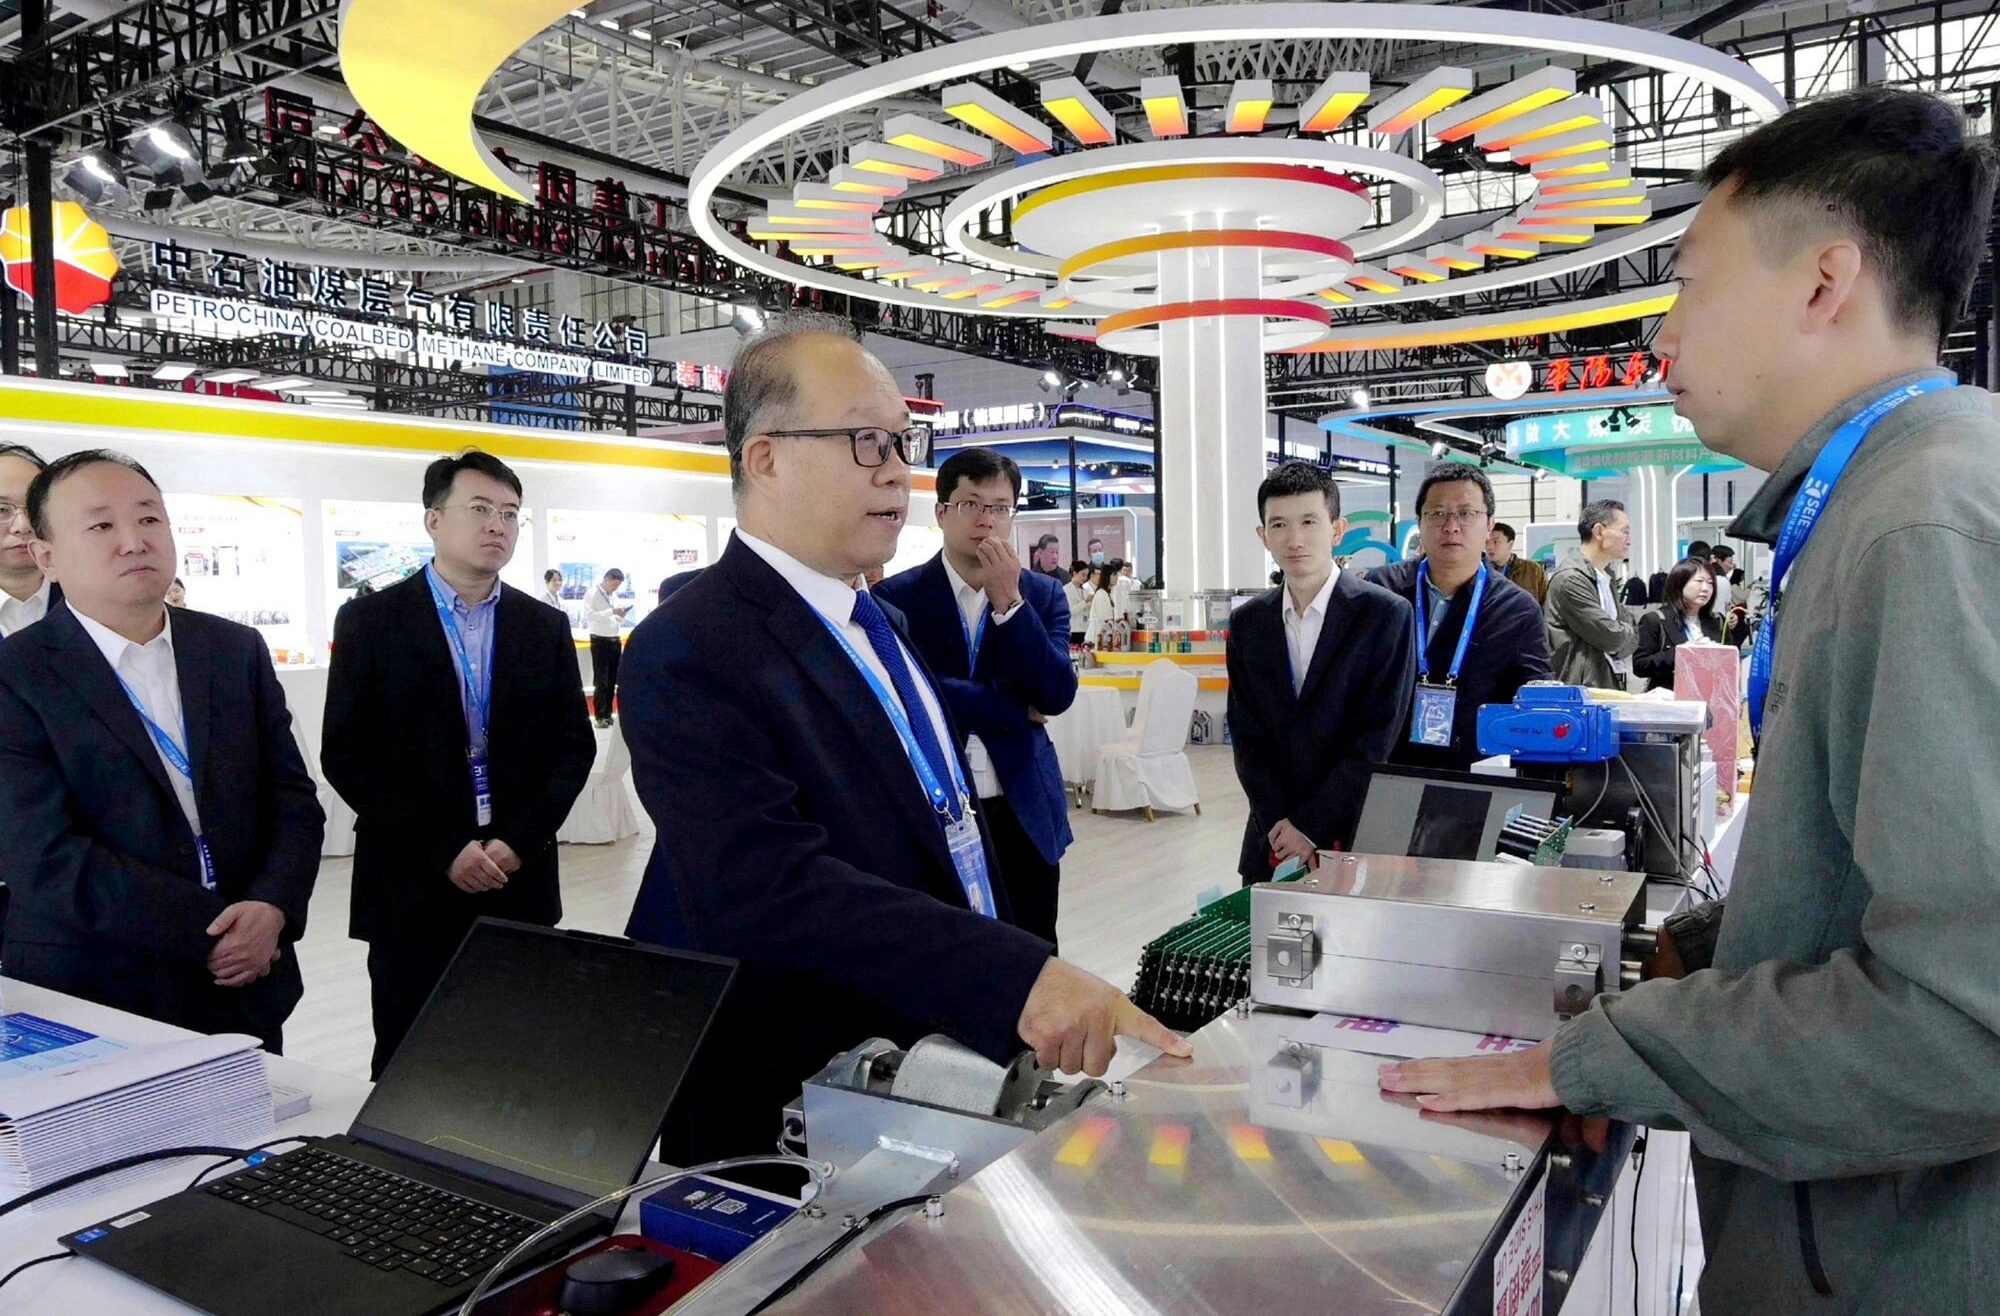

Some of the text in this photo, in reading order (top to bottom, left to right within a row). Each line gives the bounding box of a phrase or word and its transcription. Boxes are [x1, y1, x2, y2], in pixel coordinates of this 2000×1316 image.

[152, 238, 648, 358] 中石油煤层气有限责任公司
[156, 292, 650, 385] PETROCHINA COALBED METHANE COMPANY LIMITED
[1798, 499, 1820, 528] SEIE
[1508, 1217, 1526, 1265] SIDE
[1496, 1252, 1507, 1287] UP
